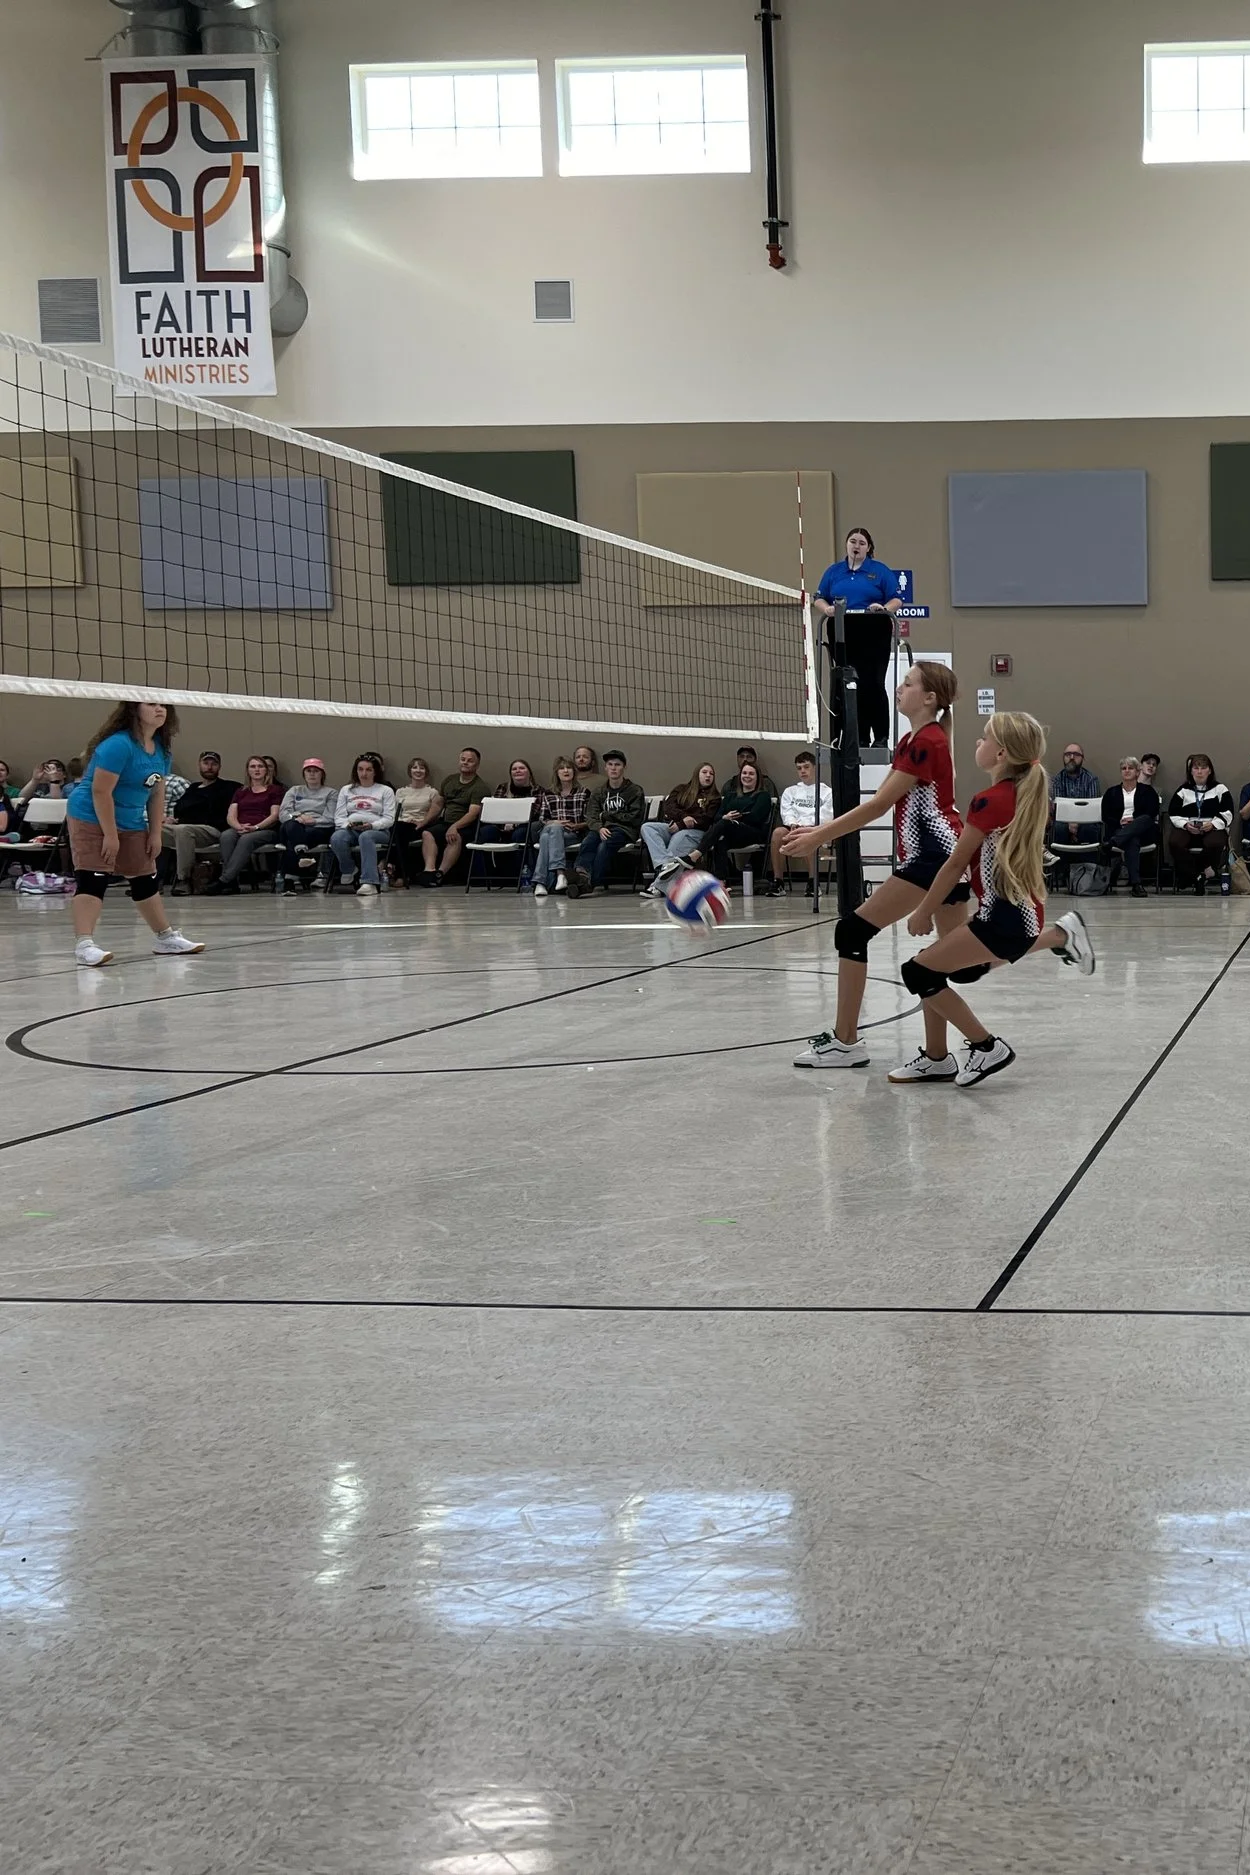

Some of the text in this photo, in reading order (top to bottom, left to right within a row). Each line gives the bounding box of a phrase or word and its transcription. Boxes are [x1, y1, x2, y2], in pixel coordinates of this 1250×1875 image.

[135, 289, 252, 334] FAITH
[141, 337, 249, 358] LUTHERAN
[144, 364, 249, 384] MINISTRIES
